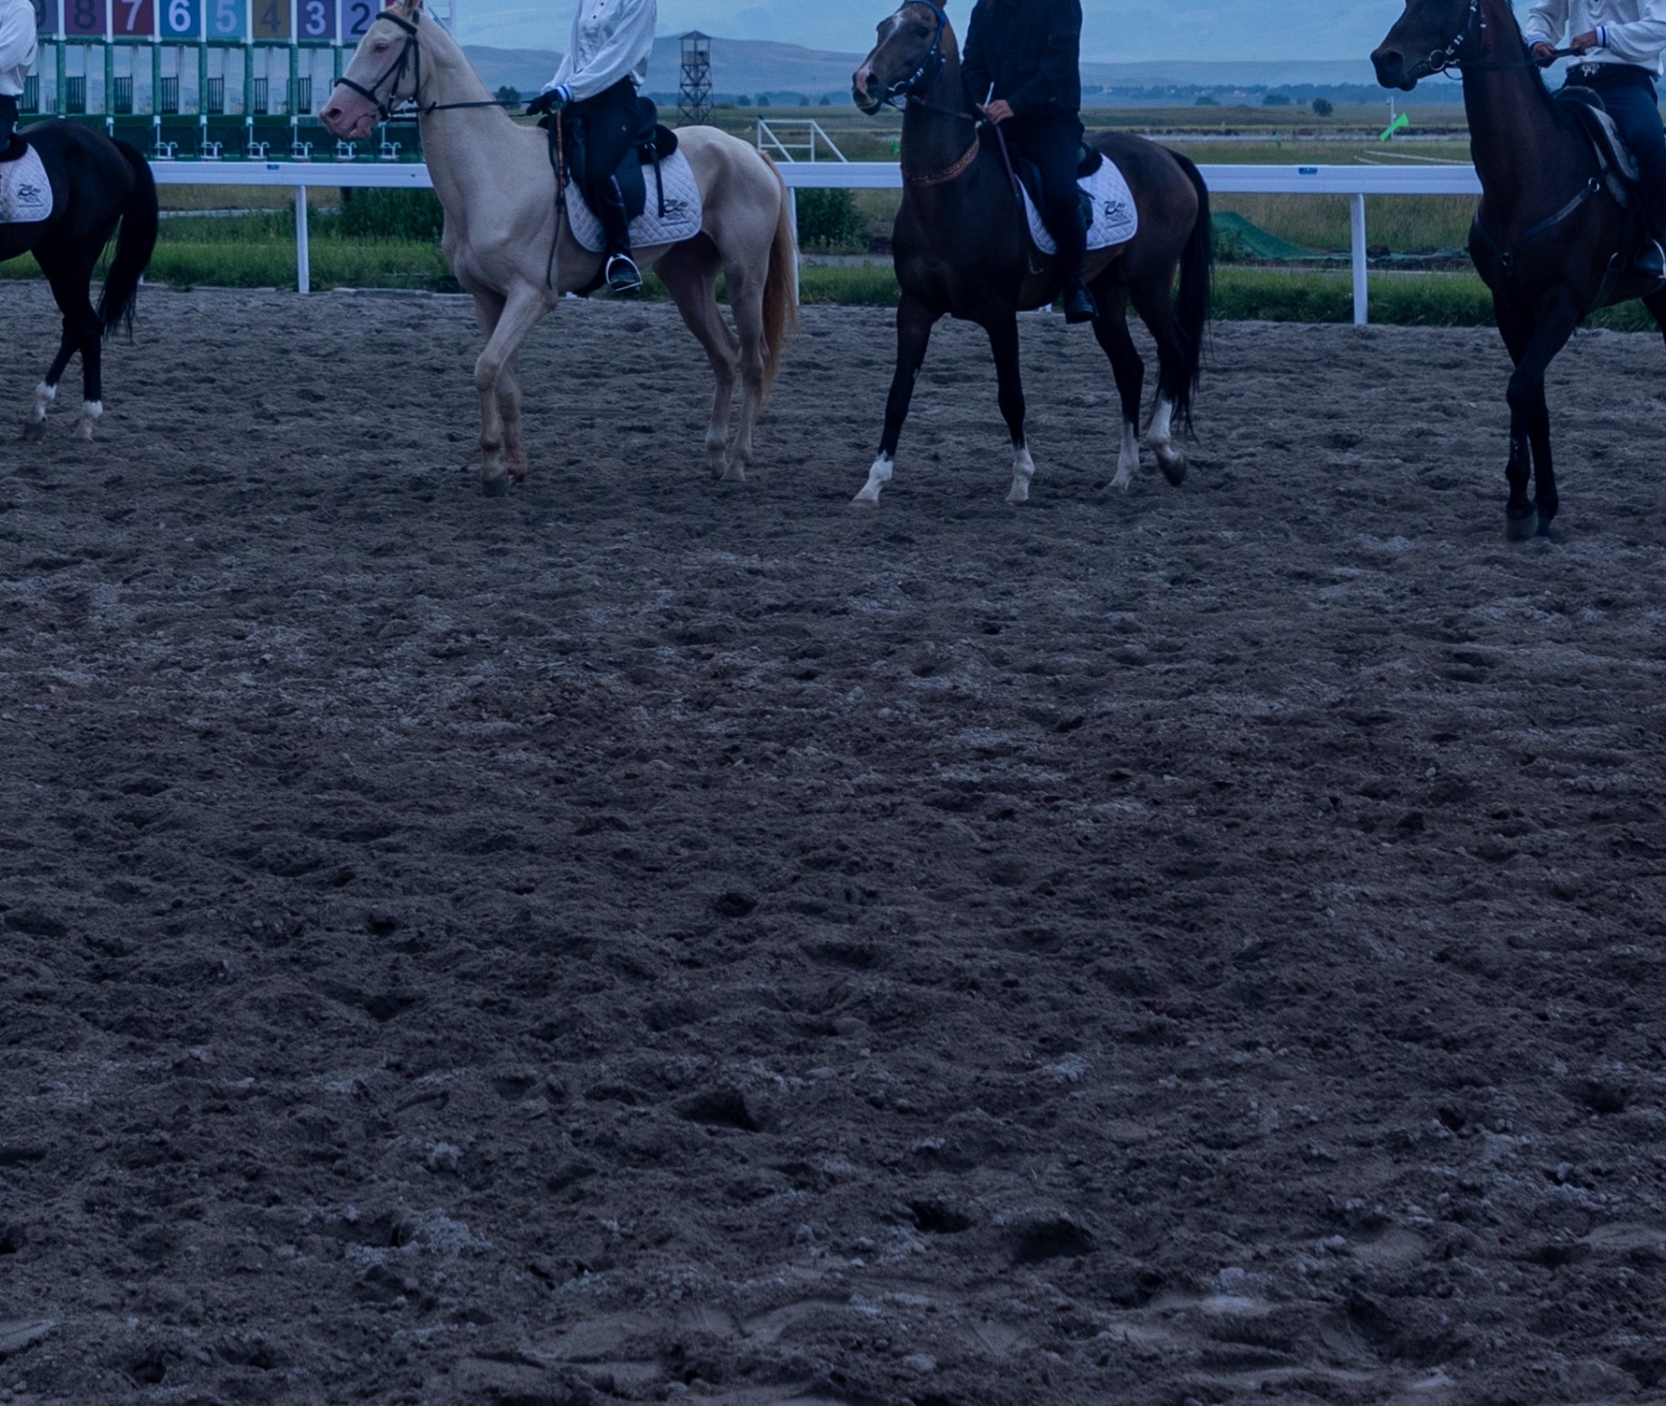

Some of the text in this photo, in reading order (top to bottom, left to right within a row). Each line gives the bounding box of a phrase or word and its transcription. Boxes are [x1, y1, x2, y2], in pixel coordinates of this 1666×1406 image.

[215, 0, 237, 33] 5
[260, 0, 281, 34] 4
[305, 1, 327, 35] 3
[350, 2, 370, 35] 2
